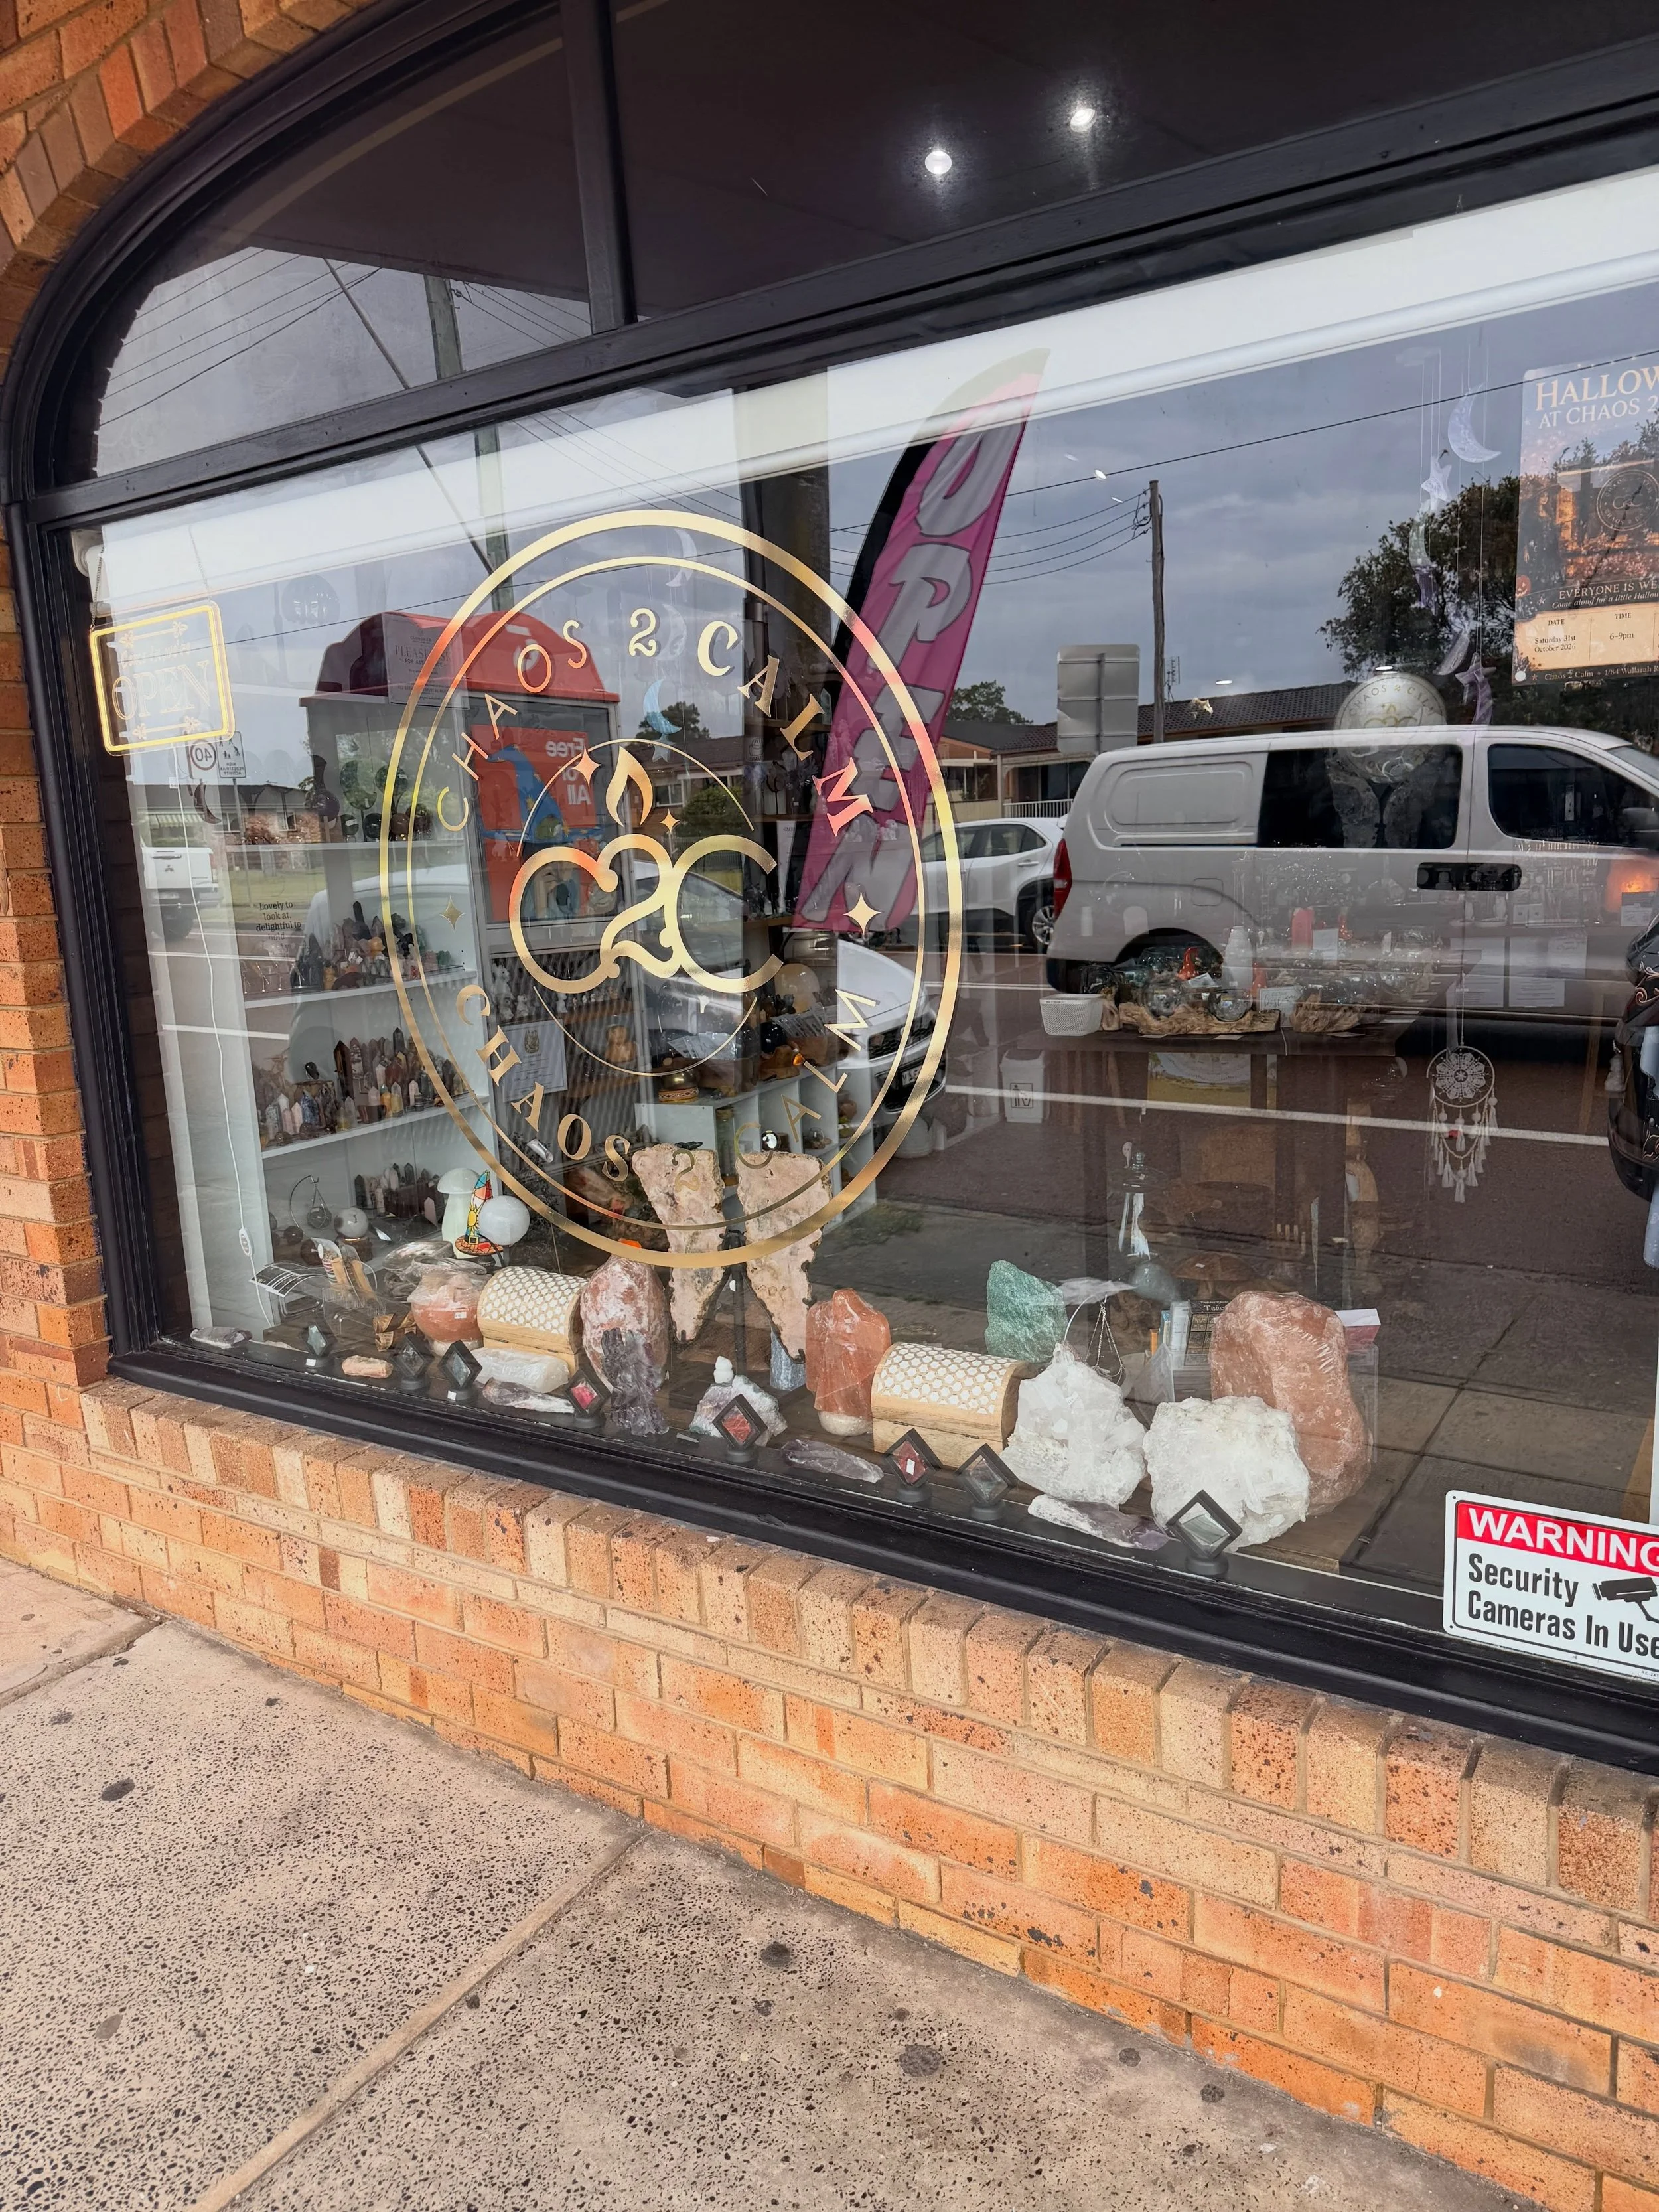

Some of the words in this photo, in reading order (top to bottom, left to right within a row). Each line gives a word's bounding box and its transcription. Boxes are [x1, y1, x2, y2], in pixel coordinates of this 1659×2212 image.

[1538, 410, 1561, 430] AT
[1566, 398, 1640, 425] CHAOS
[1646, 395, 1659, 413] 2
[1559, 584, 1620, 599] EVERYONE
[1624, 583, 1634, 591] IS
[1638, 581, 1658, 590] WE
[1574, 597, 1595, 607] along
[1596, 596, 1607, 605] for
[1534, 636, 1562, 644] Saturday
[111, 660, 211, 721] OPEN
[437, 620, 587, 832] CHAOS
[629, 607, 657, 658] 2
[697, 620, 874, 836] CALM
[259, 901, 285, 911] Lovely
[263, 911, 281, 921] look
[256, 921, 293, 932] delightful
[457, 984, 631, 1182] CHAOS
[672, 1149, 700, 1193] 2
[735, 989, 878, 1170] CALM
[1468, 1507, 1659, 1572] WARNING
[1469, 1553, 1579, 1608] Security
[1468, 1590, 1576, 1640] Cameras
[1585, 1614, 1609, 1649] In
[1619, 1621, 1659, 1659] Use
